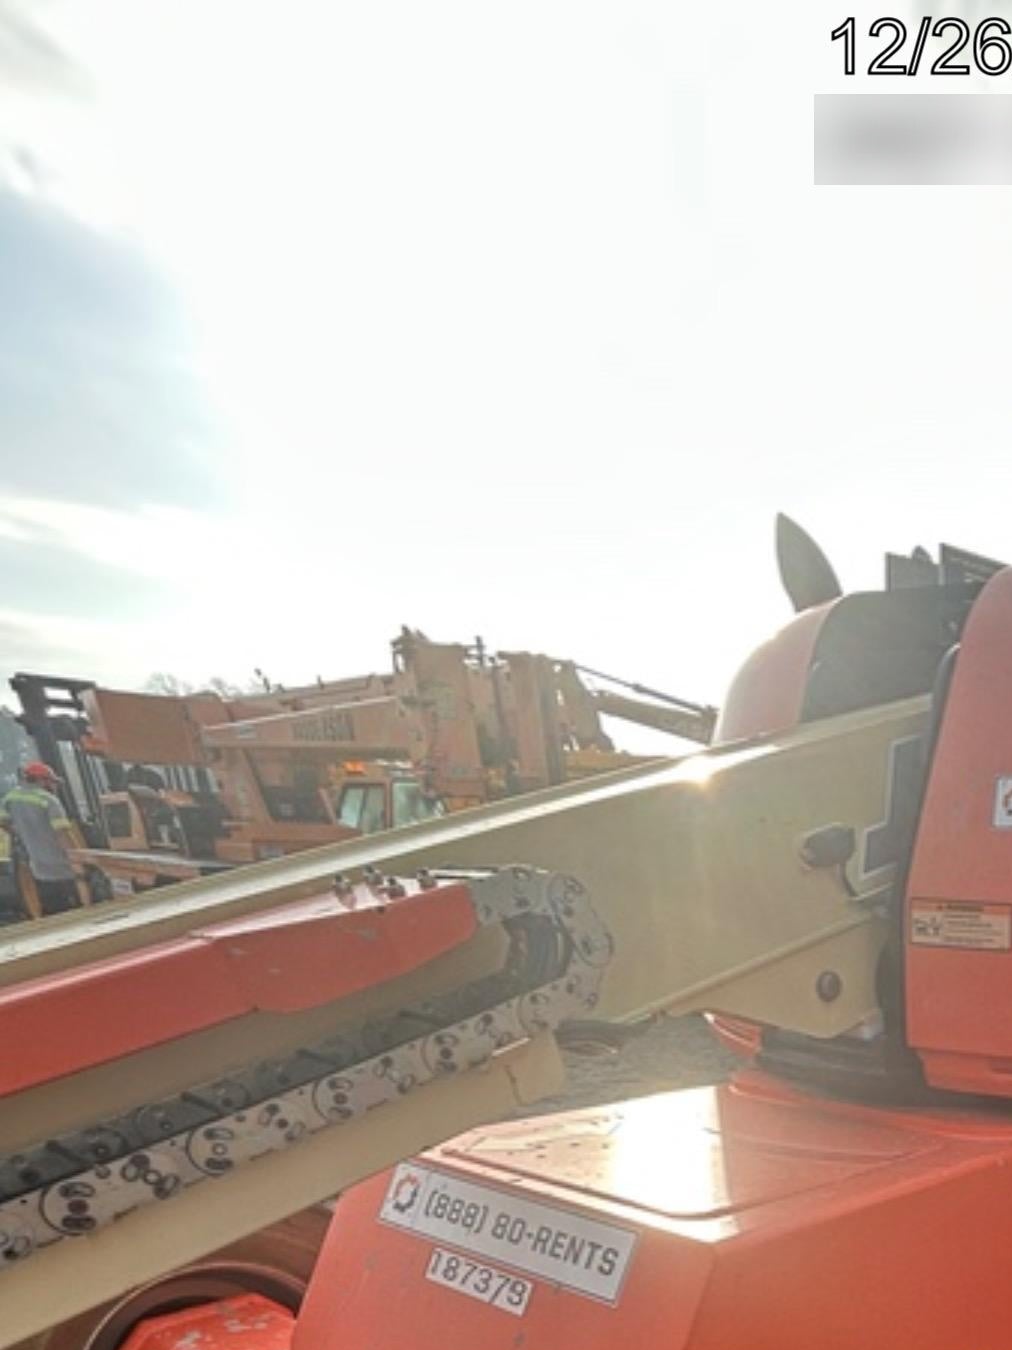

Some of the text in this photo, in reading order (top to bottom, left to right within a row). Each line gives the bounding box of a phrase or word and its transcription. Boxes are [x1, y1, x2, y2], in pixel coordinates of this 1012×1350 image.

[423, 1189, 620, 1277] (888) 80-RENTS
[429, 1250, 529, 1308] 187379
